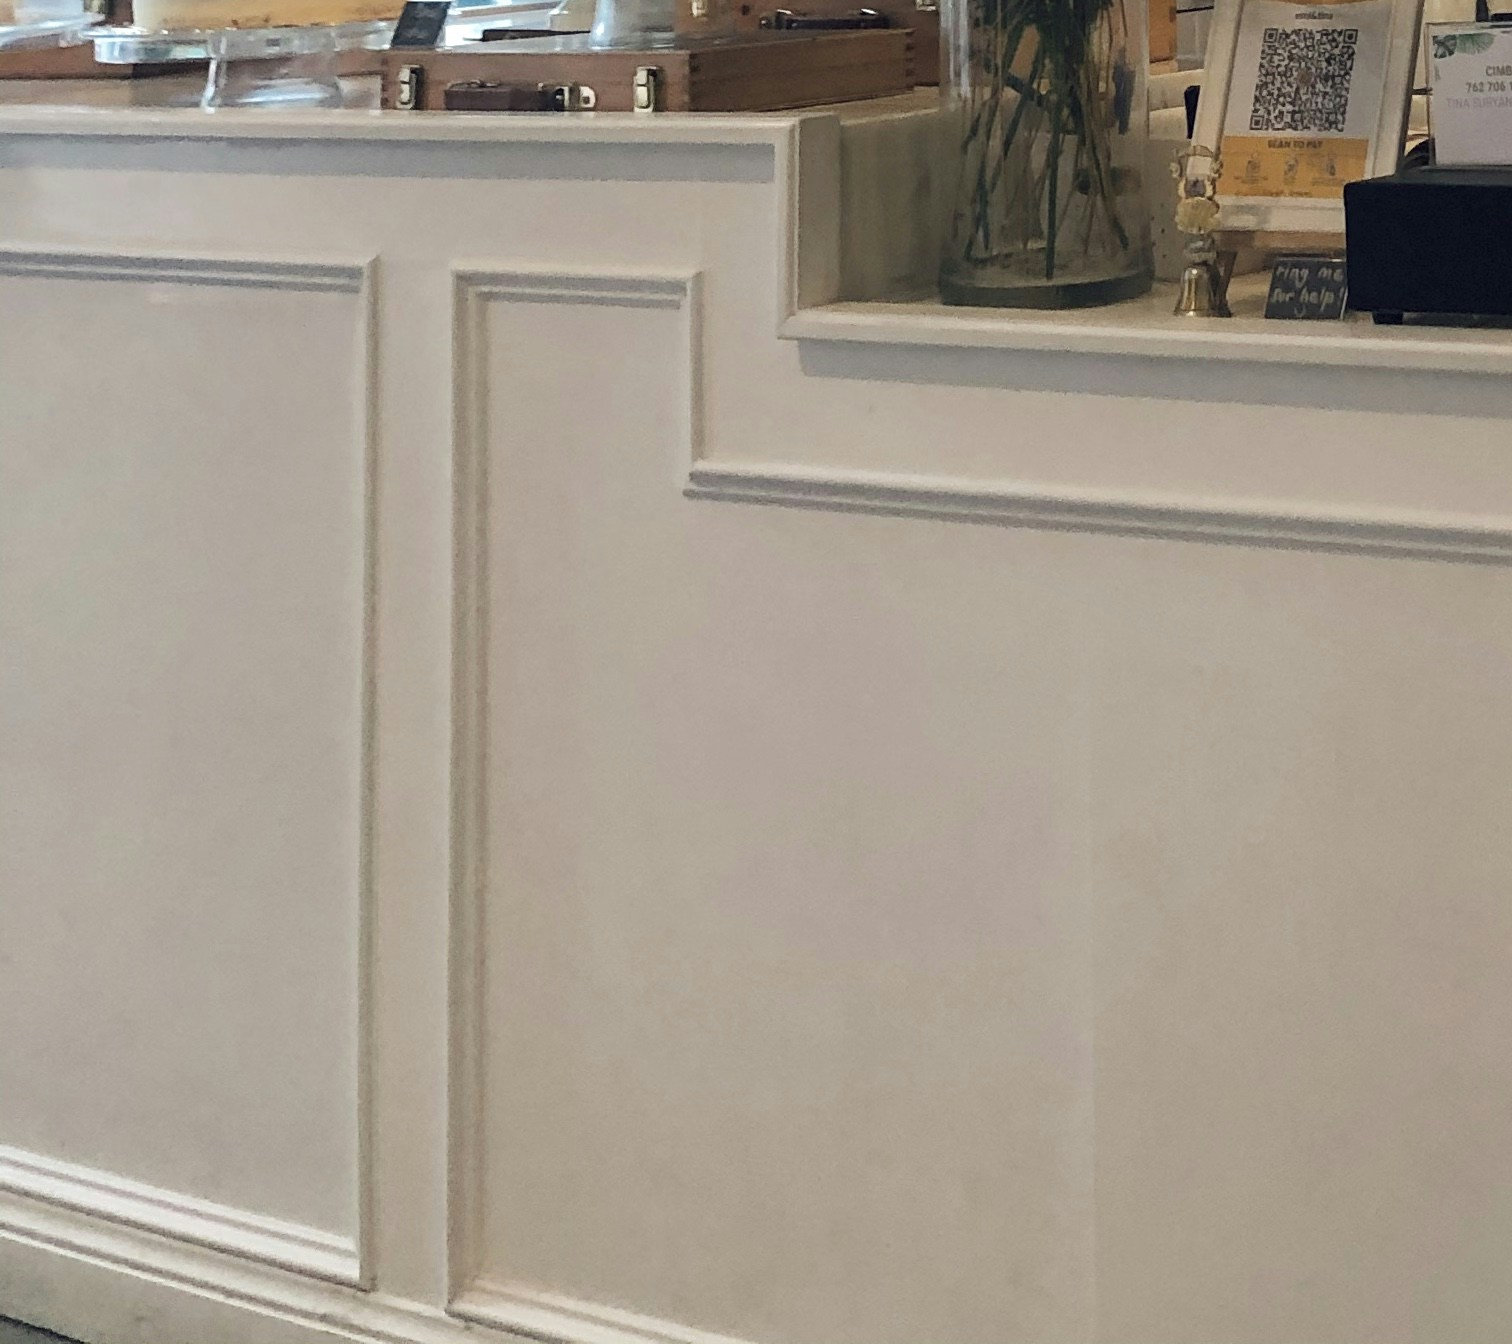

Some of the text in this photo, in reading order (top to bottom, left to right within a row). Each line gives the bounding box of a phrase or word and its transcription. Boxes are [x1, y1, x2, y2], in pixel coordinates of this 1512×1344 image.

[1485, 65, 1512, 77] CIMB
[1466, 81, 1485, 93] 762
[1487, 80, 1506, 92] 706
[1446, 98, 1470, 109] TINA
[1276, 265, 1309, 288] ring
[1270, 287, 1296, 303] for
